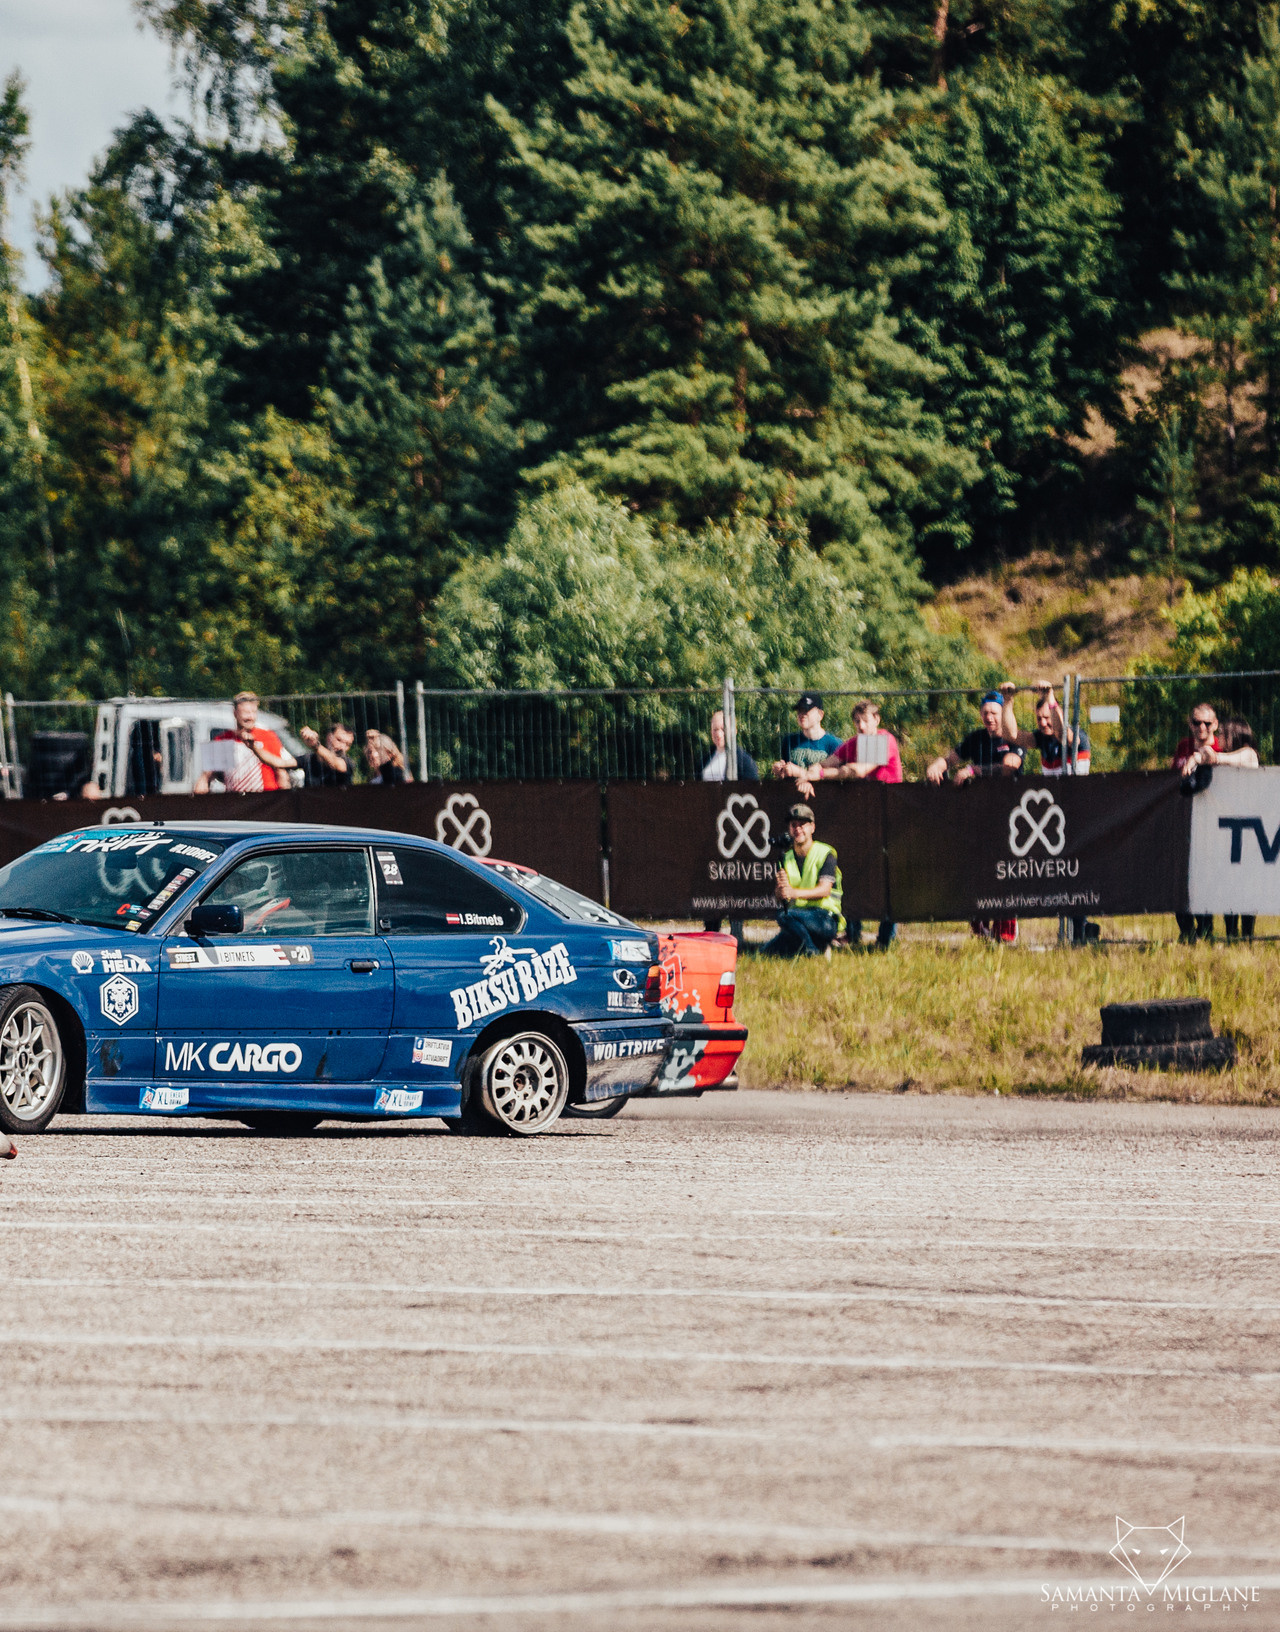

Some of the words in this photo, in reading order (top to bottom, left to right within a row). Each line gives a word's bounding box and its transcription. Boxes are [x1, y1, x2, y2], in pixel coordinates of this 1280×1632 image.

[101, 950, 123, 959] Shell
[102, 955, 152, 973] HELIX
[165, 1042, 207, 1071] MK
[208, 1042, 303, 1073] CARGO
